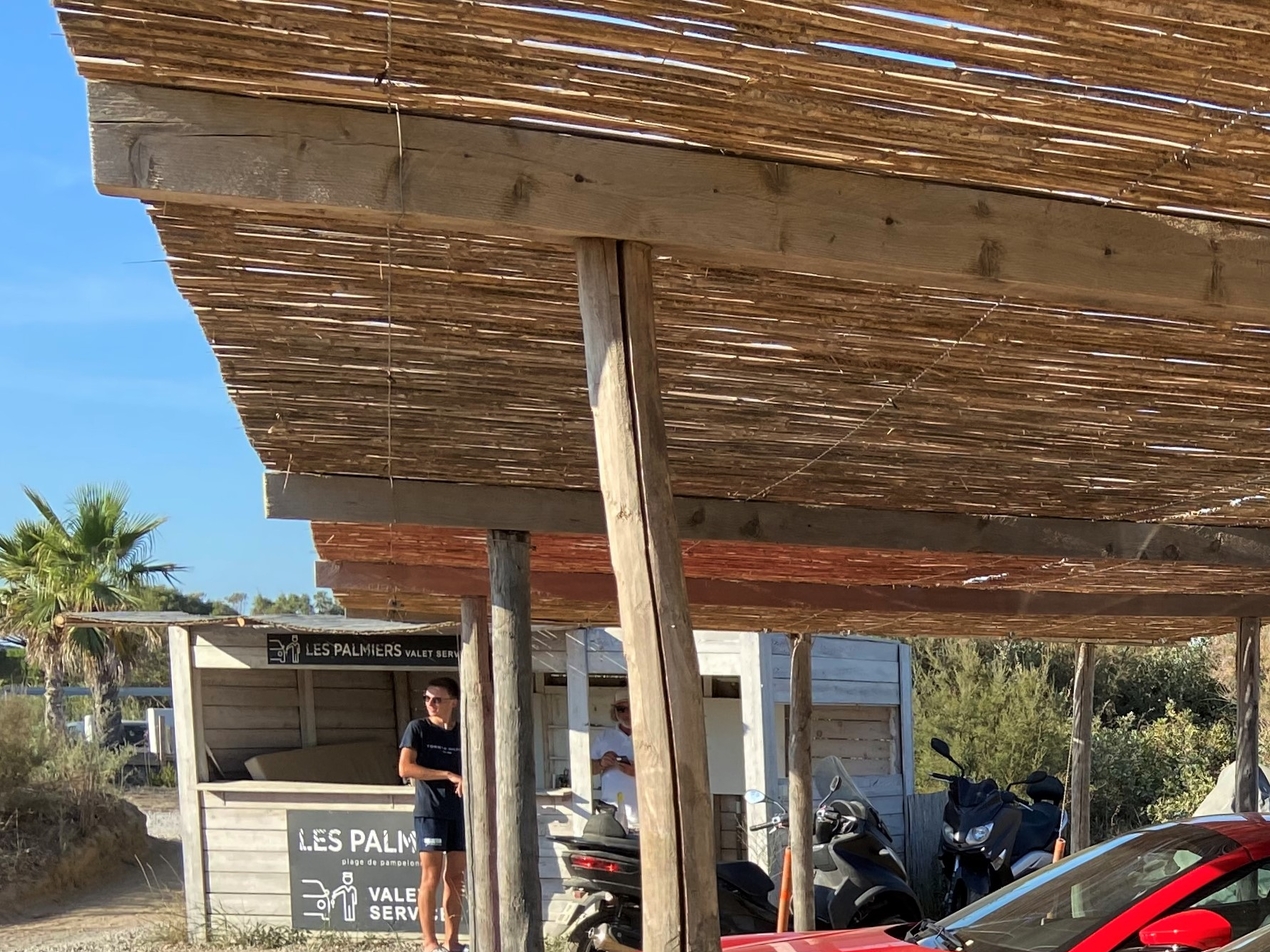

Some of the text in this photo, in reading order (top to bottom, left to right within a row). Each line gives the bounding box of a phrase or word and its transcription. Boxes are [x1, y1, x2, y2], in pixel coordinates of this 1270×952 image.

[306, 643, 330, 657] LES
[334, 643, 402, 657] PALMIERS
[405, 650, 432, 658] VALET
[299, 828, 343, 852] LES
[342, 858, 364, 867] plage
[367, 858, 377, 866] de
[368, 887, 420, 903] VALE
